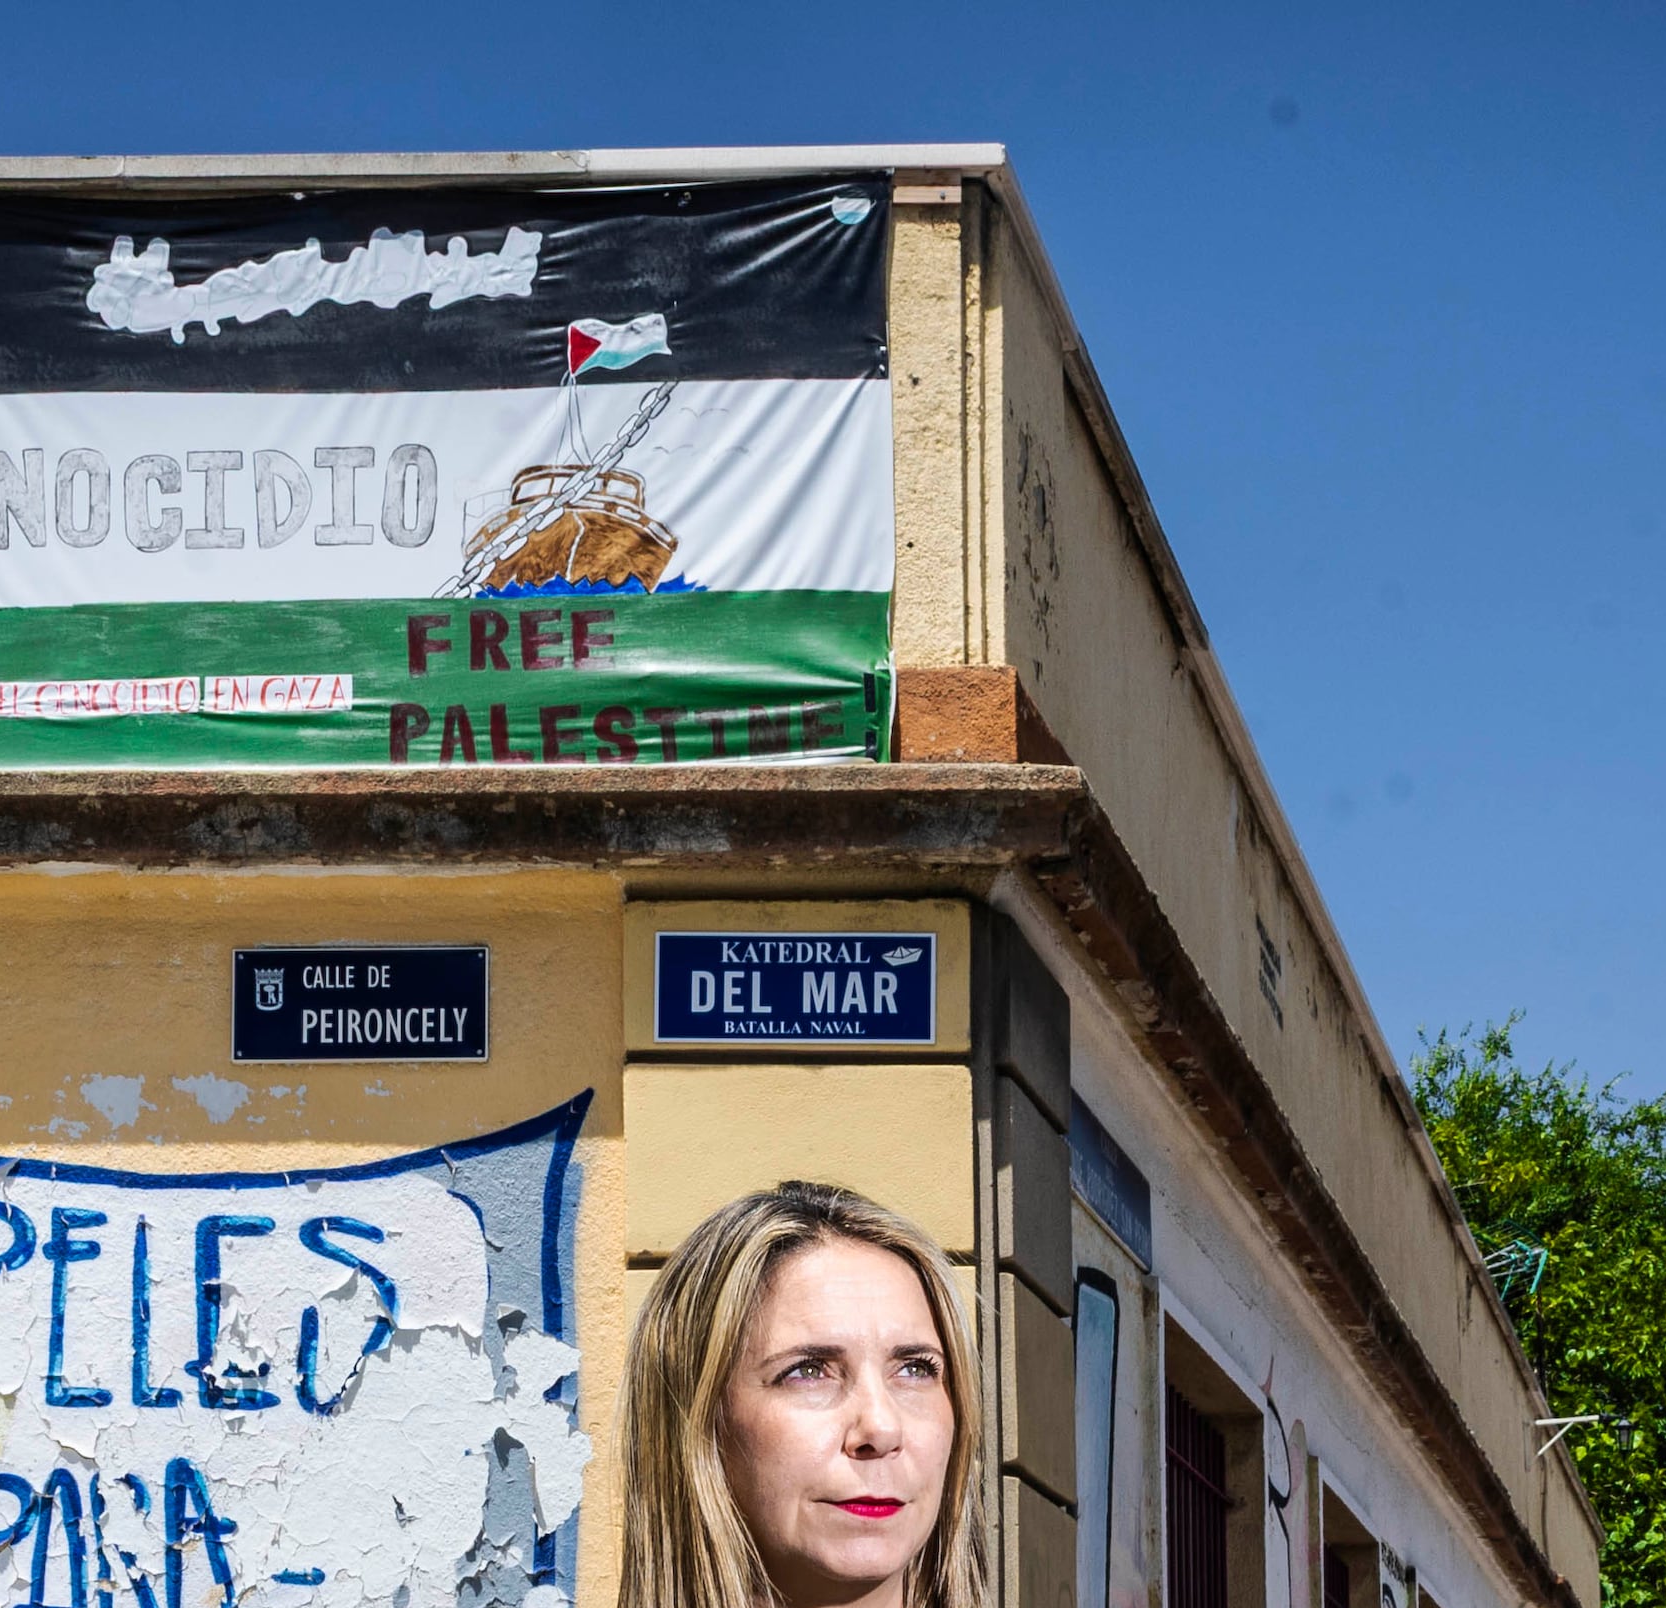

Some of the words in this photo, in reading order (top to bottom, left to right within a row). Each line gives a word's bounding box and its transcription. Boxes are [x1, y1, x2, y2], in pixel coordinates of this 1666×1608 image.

[407, 609, 615, 673] FREE
[35, 678, 198, 716] GENOCIDIO
[213, 677, 250, 711] EN
[259, 676, 350, 710] GAZA
[389, 701, 844, 764] PALESTINE
[720, 941, 871, 964] KATEDRAL
[302, 965, 355, 989] CALLE
[367, 965, 391, 988] DE
[691, 970, 772, 1014] DEL
[802, 971, 898, 1014] MAR
[301, 1007, 468, 1044] PEIRONCELY
[724, 1020, 802, 1035] BATALLA
[810, 1020, 866, 1035] NAVAL
